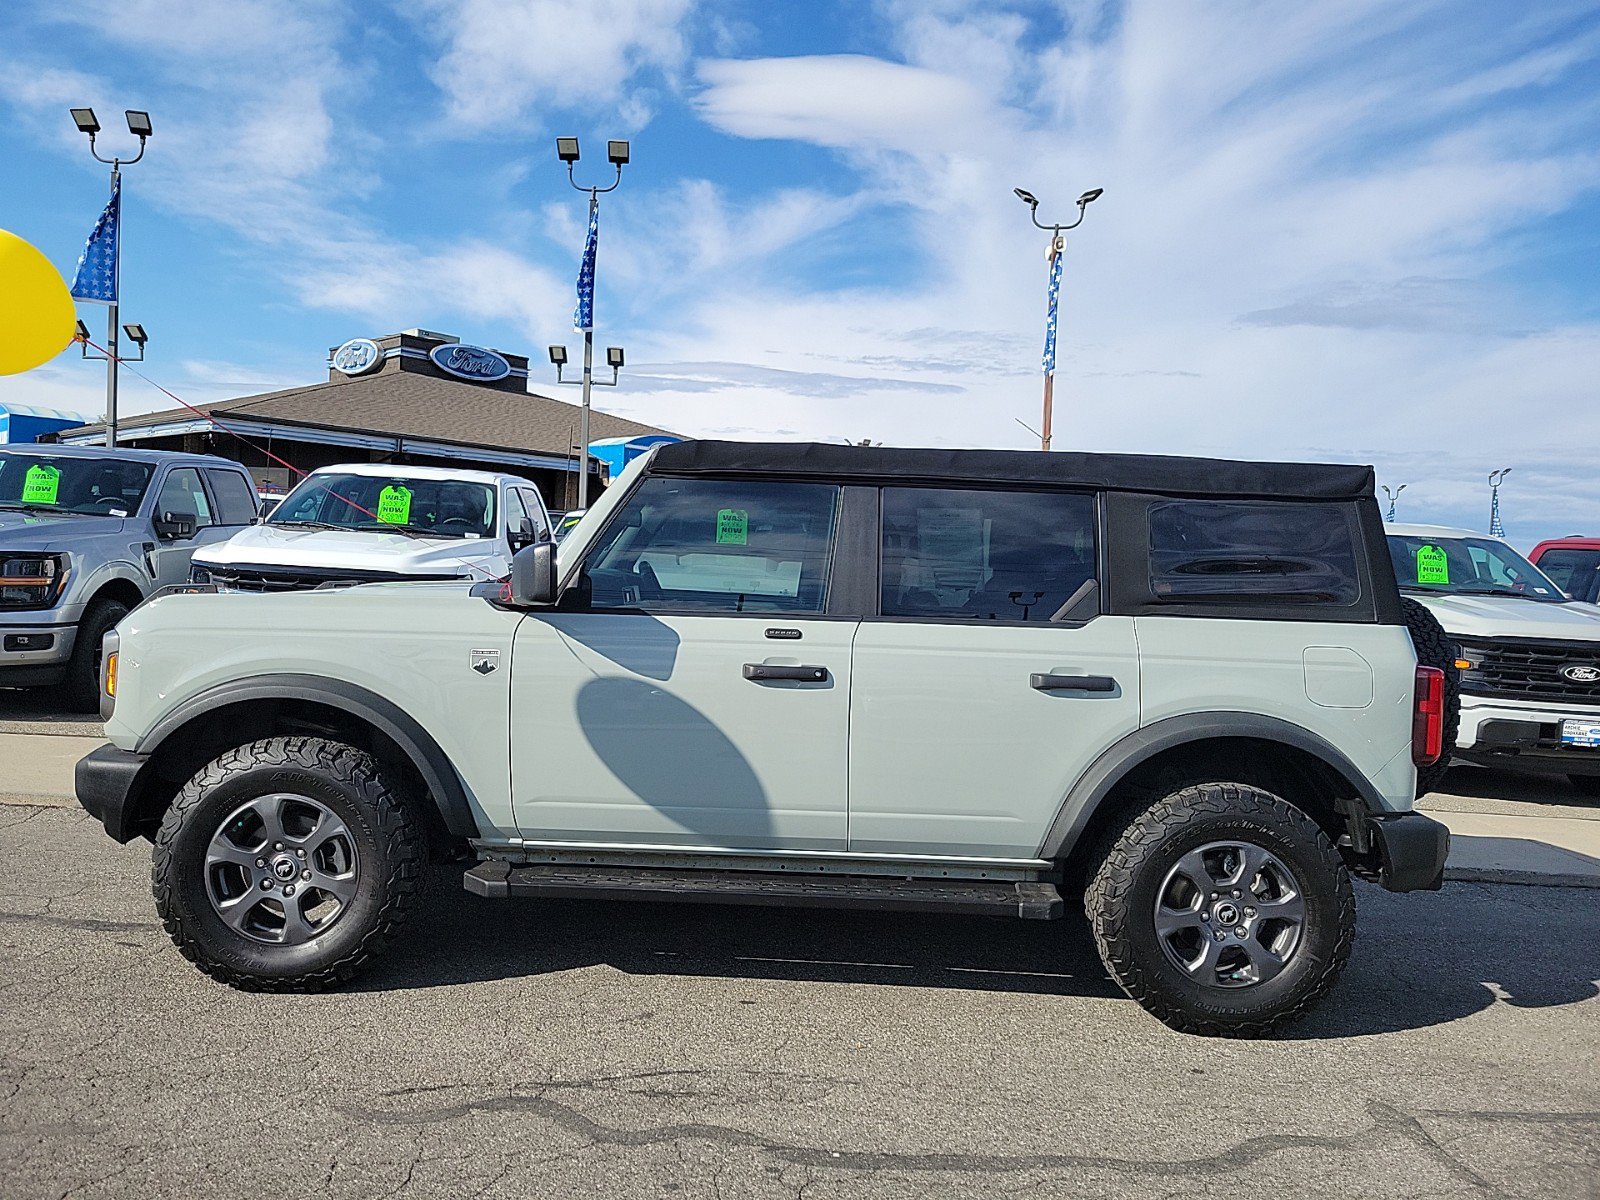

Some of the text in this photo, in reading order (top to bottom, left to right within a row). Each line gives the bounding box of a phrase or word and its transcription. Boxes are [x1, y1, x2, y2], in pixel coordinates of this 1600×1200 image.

[447, 347, 497, 375] Ford
[722, 514, 743, 522] WAS
[1572, 668, 1597, 679] Ford
